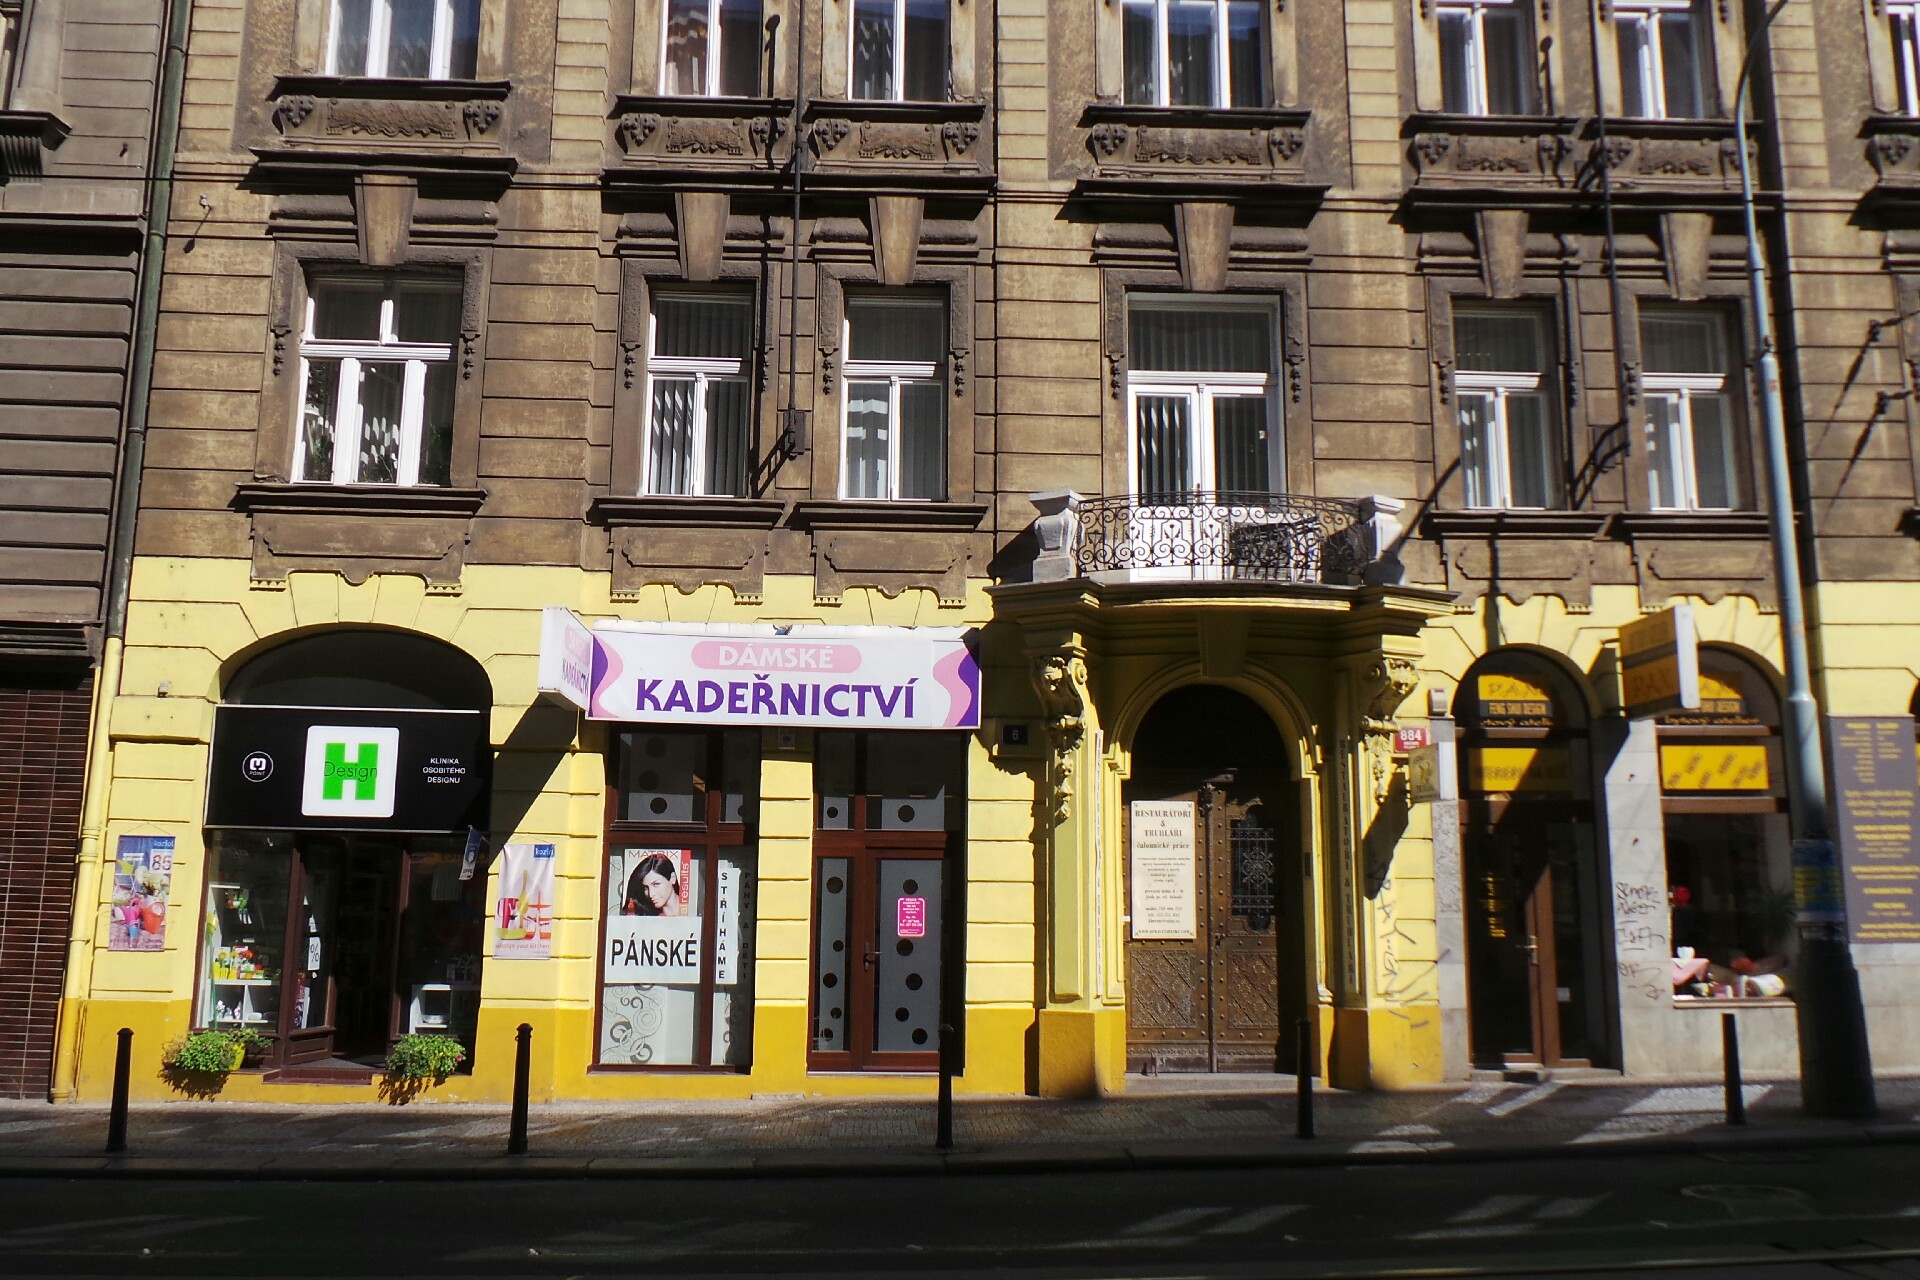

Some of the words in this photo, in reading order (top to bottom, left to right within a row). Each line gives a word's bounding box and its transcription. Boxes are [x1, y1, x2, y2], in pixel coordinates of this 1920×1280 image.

[719, 644, 834, 669] DÁMSKÉ
[636, 672, 920, 719] KADEŘNICTVÍ
[1400, 729, 1422, 741] 884
[322, 742, 379, 801] H
[323, 760, 378, 783] Design
[422, 765, 466, 775] OSOBITÉHO
[430, 757, 459, 765] KLINIKA
[427, 776, 461, 784] DESIGNU
[628, 850, 679, 859] MATRIX
[681, 862, 690, 903] results
[717, 872, 728, 979] STŘÍHÁME
[610, 932, 698, 967] PÁNSKÉ
